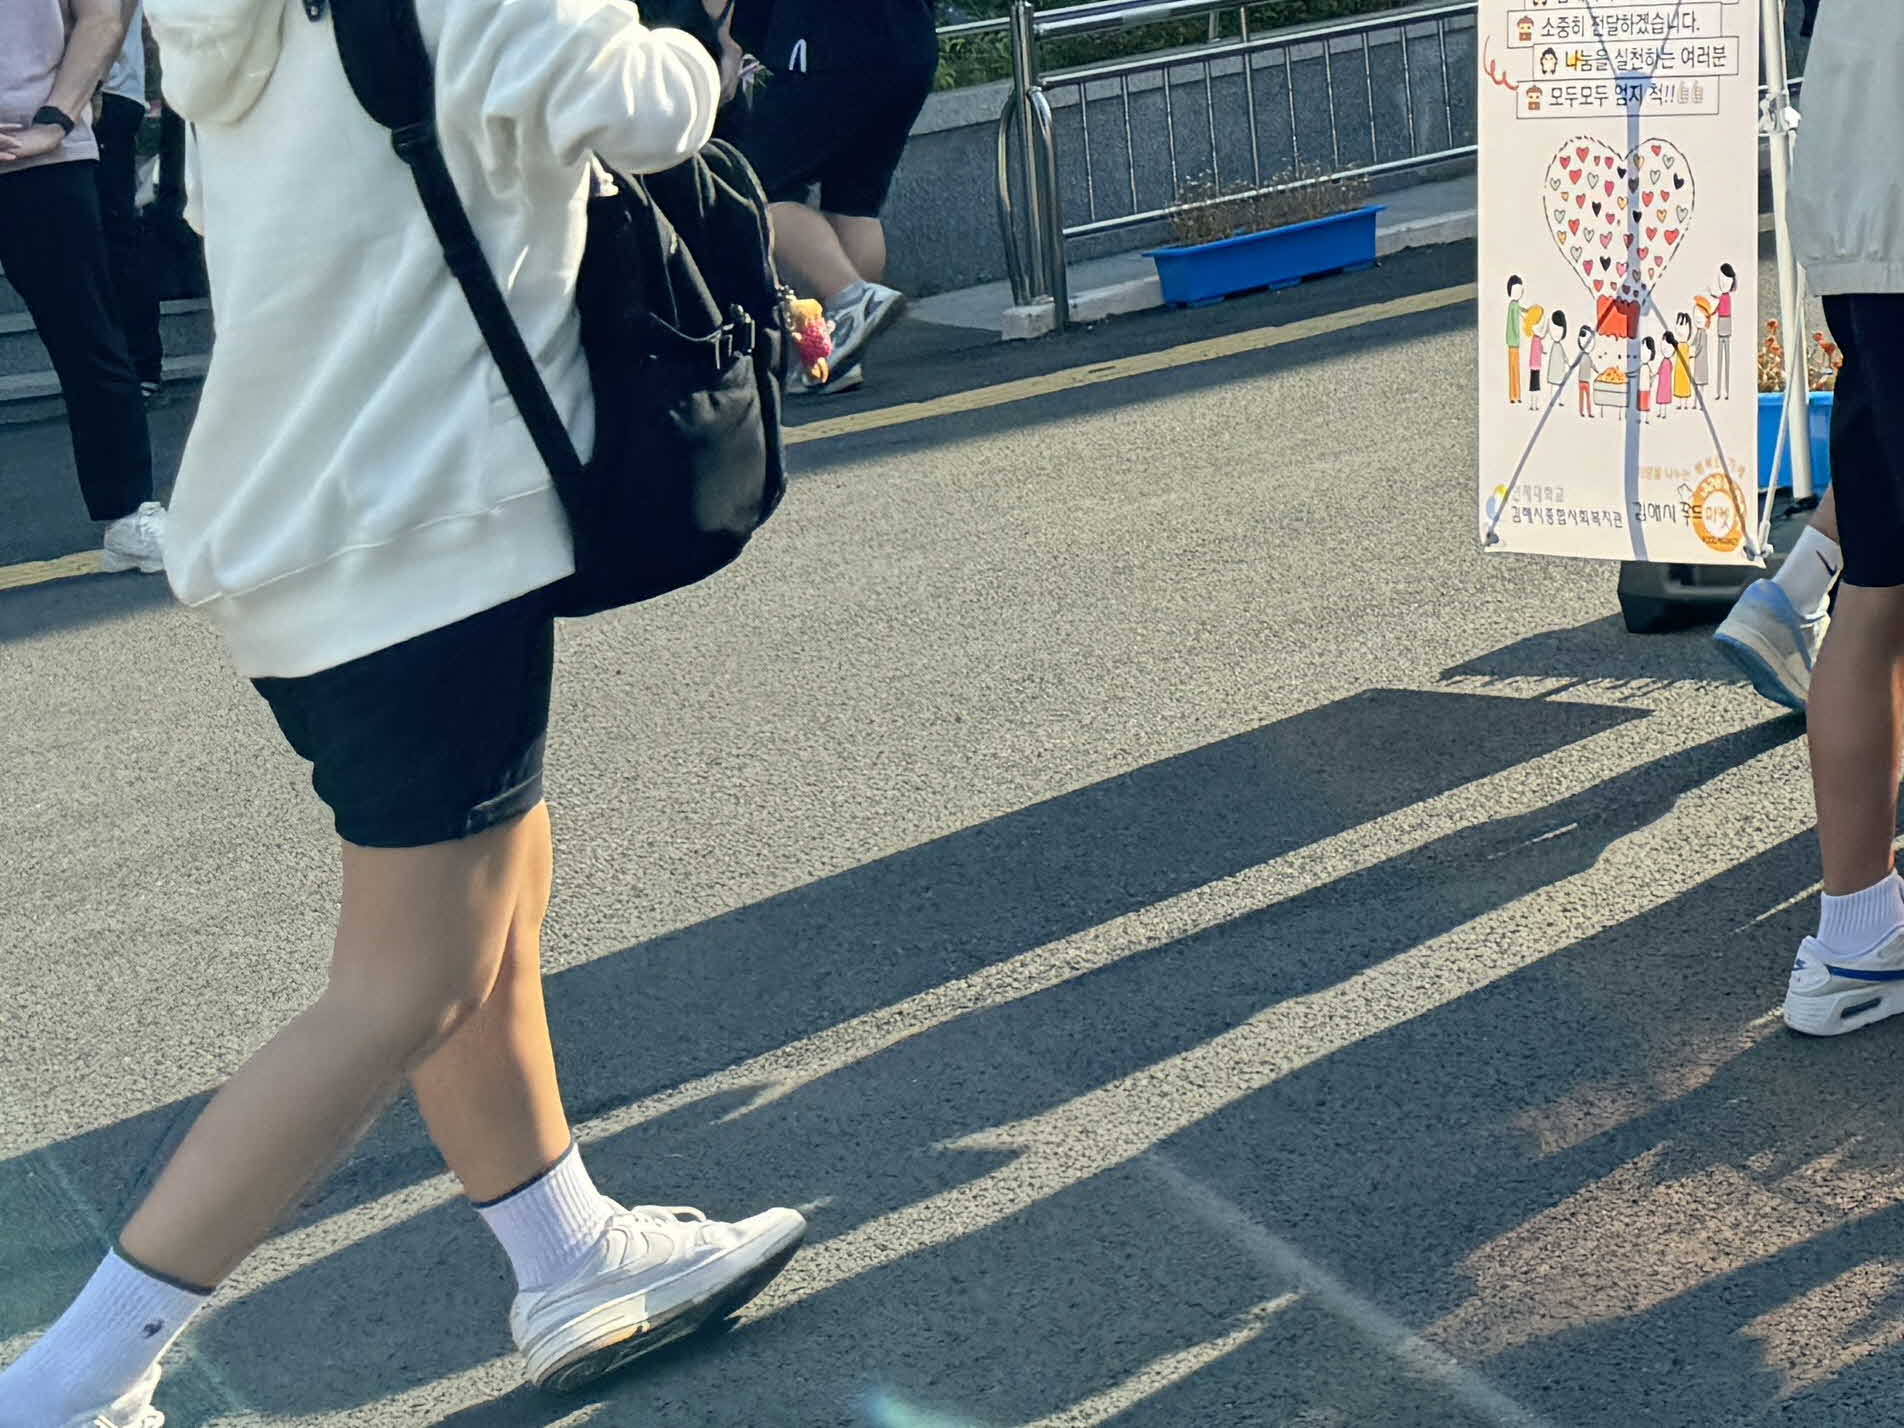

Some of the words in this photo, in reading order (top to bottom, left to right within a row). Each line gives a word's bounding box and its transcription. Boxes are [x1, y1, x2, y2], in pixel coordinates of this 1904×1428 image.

[1541, 15, 1585, 39] 소중히
[1564, 48, 1610, 72] 나눔을
[1615, 46, 1676, 72] 실천하는
[1680, 45, 1727, 70] 여러분
[1550, 85, 1609, 108] 모두모두
[1614, 83, 1643, 107] 엄지
